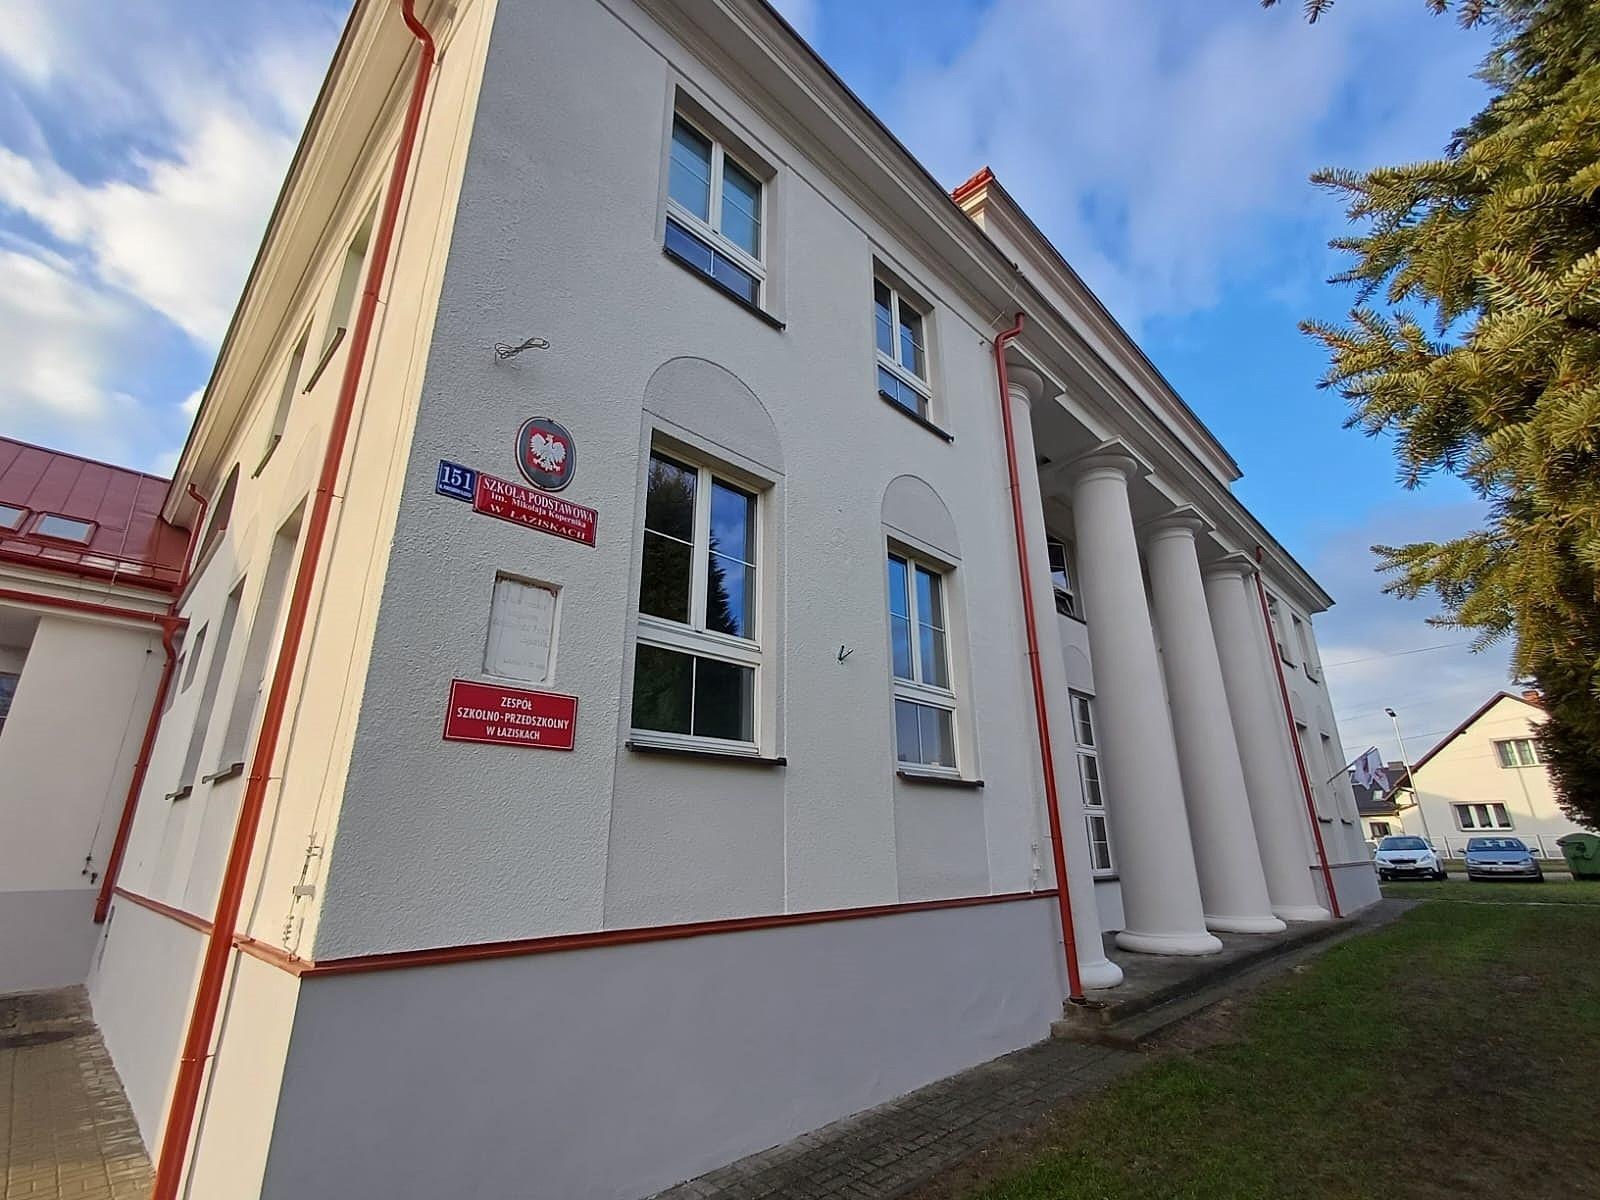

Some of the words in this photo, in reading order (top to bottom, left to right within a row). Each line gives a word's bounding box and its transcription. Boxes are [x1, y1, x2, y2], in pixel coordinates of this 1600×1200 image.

[441, 466, 472, 490] 151
[528, 492, 593, 524] PODSTAWOWA
[548, 510, 586, 529] Kopernika
[500, 696, 533, 711] ZESPÓŁ
[486, 726, 496, 736] W
[497, 728, 541, 741] ŁAZISKACH
